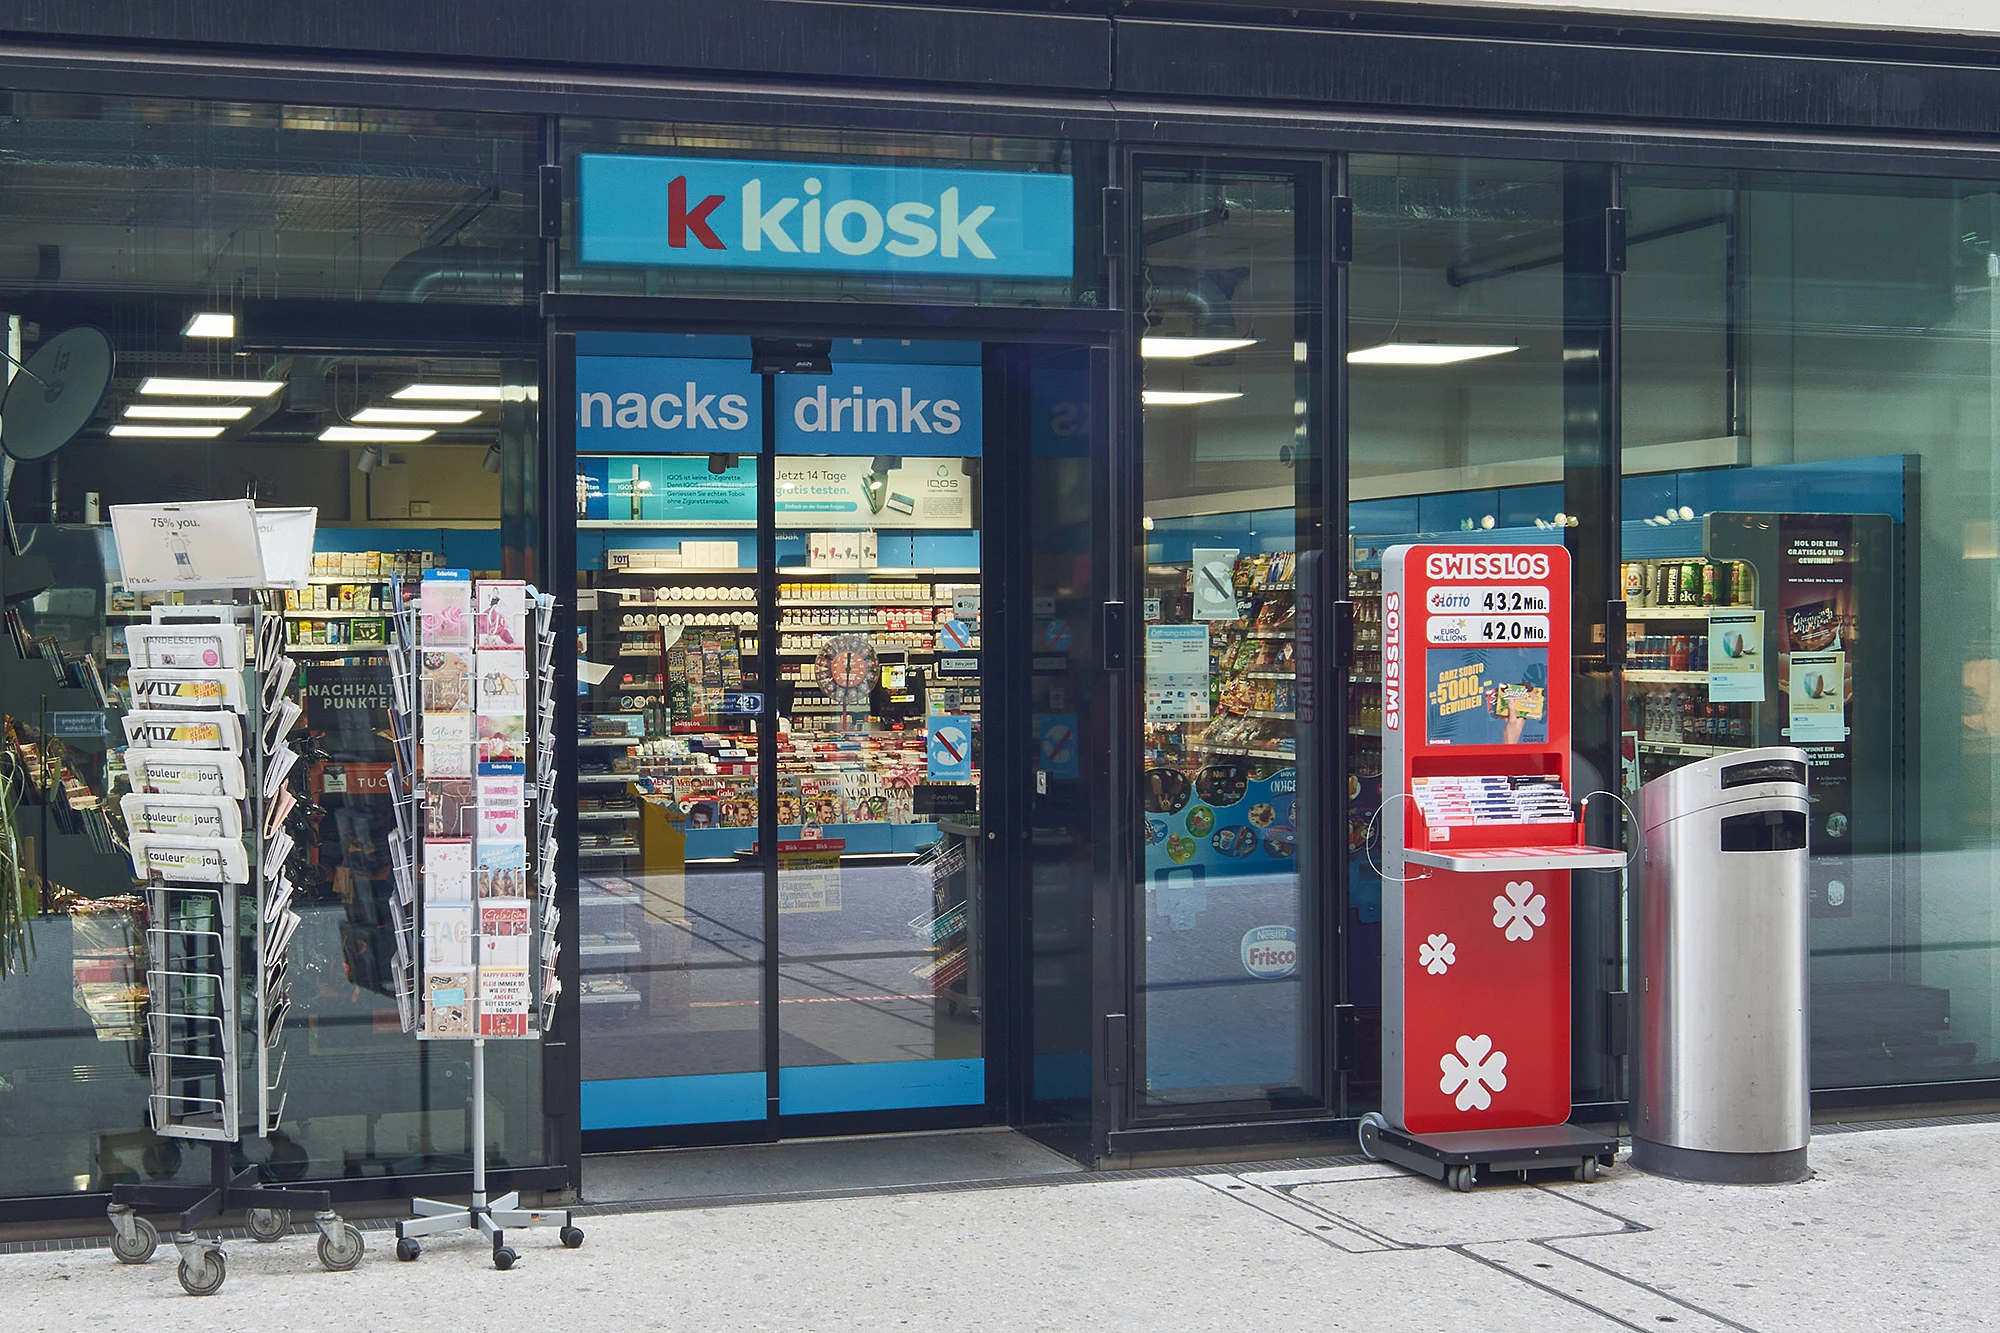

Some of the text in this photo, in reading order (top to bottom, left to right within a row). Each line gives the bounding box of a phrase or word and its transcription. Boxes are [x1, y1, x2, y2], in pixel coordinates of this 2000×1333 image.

[668, 175, 997, 259] k kiosk
[576, 382, 961, 435] nacks drinks
[667, 474, 683, 482] IQOS
[775, 470, 847, 483] Jetzt 14 Tage
[926, 479, 959, 489] IQOS
[775, 485, 850, 498] gratis testen.
[151, 518, 201, 530] 75% you.
[1428, 555, 1548, 578] SWISSLOS
[129, 576, 141, 584] It's
[1667, 568, 1677, 603] CHOPFAB
[1441, 592, 1547, 612] LOTTO 43,2 Mio.
[1151, 628, 1204, 638] Öffnungszeiten
[1434, 634, 1467, 642] MILLIONS
[1483, 622, 1522, 641] 42,0
[1524, 626, 1547, 640] Mio.
[1386, 592, 1401, 731] SWISSLOS
[135, 681, 182, 697] WOZ
[309, 684, 395, 696] NACHHALT
[130, 727, 177, 741] WOZ
[358, 778, 410, 787] TUCN
[1256, 929, 1287, 940] Nestlé
[1249, 947, 1296, 966] Frisco
